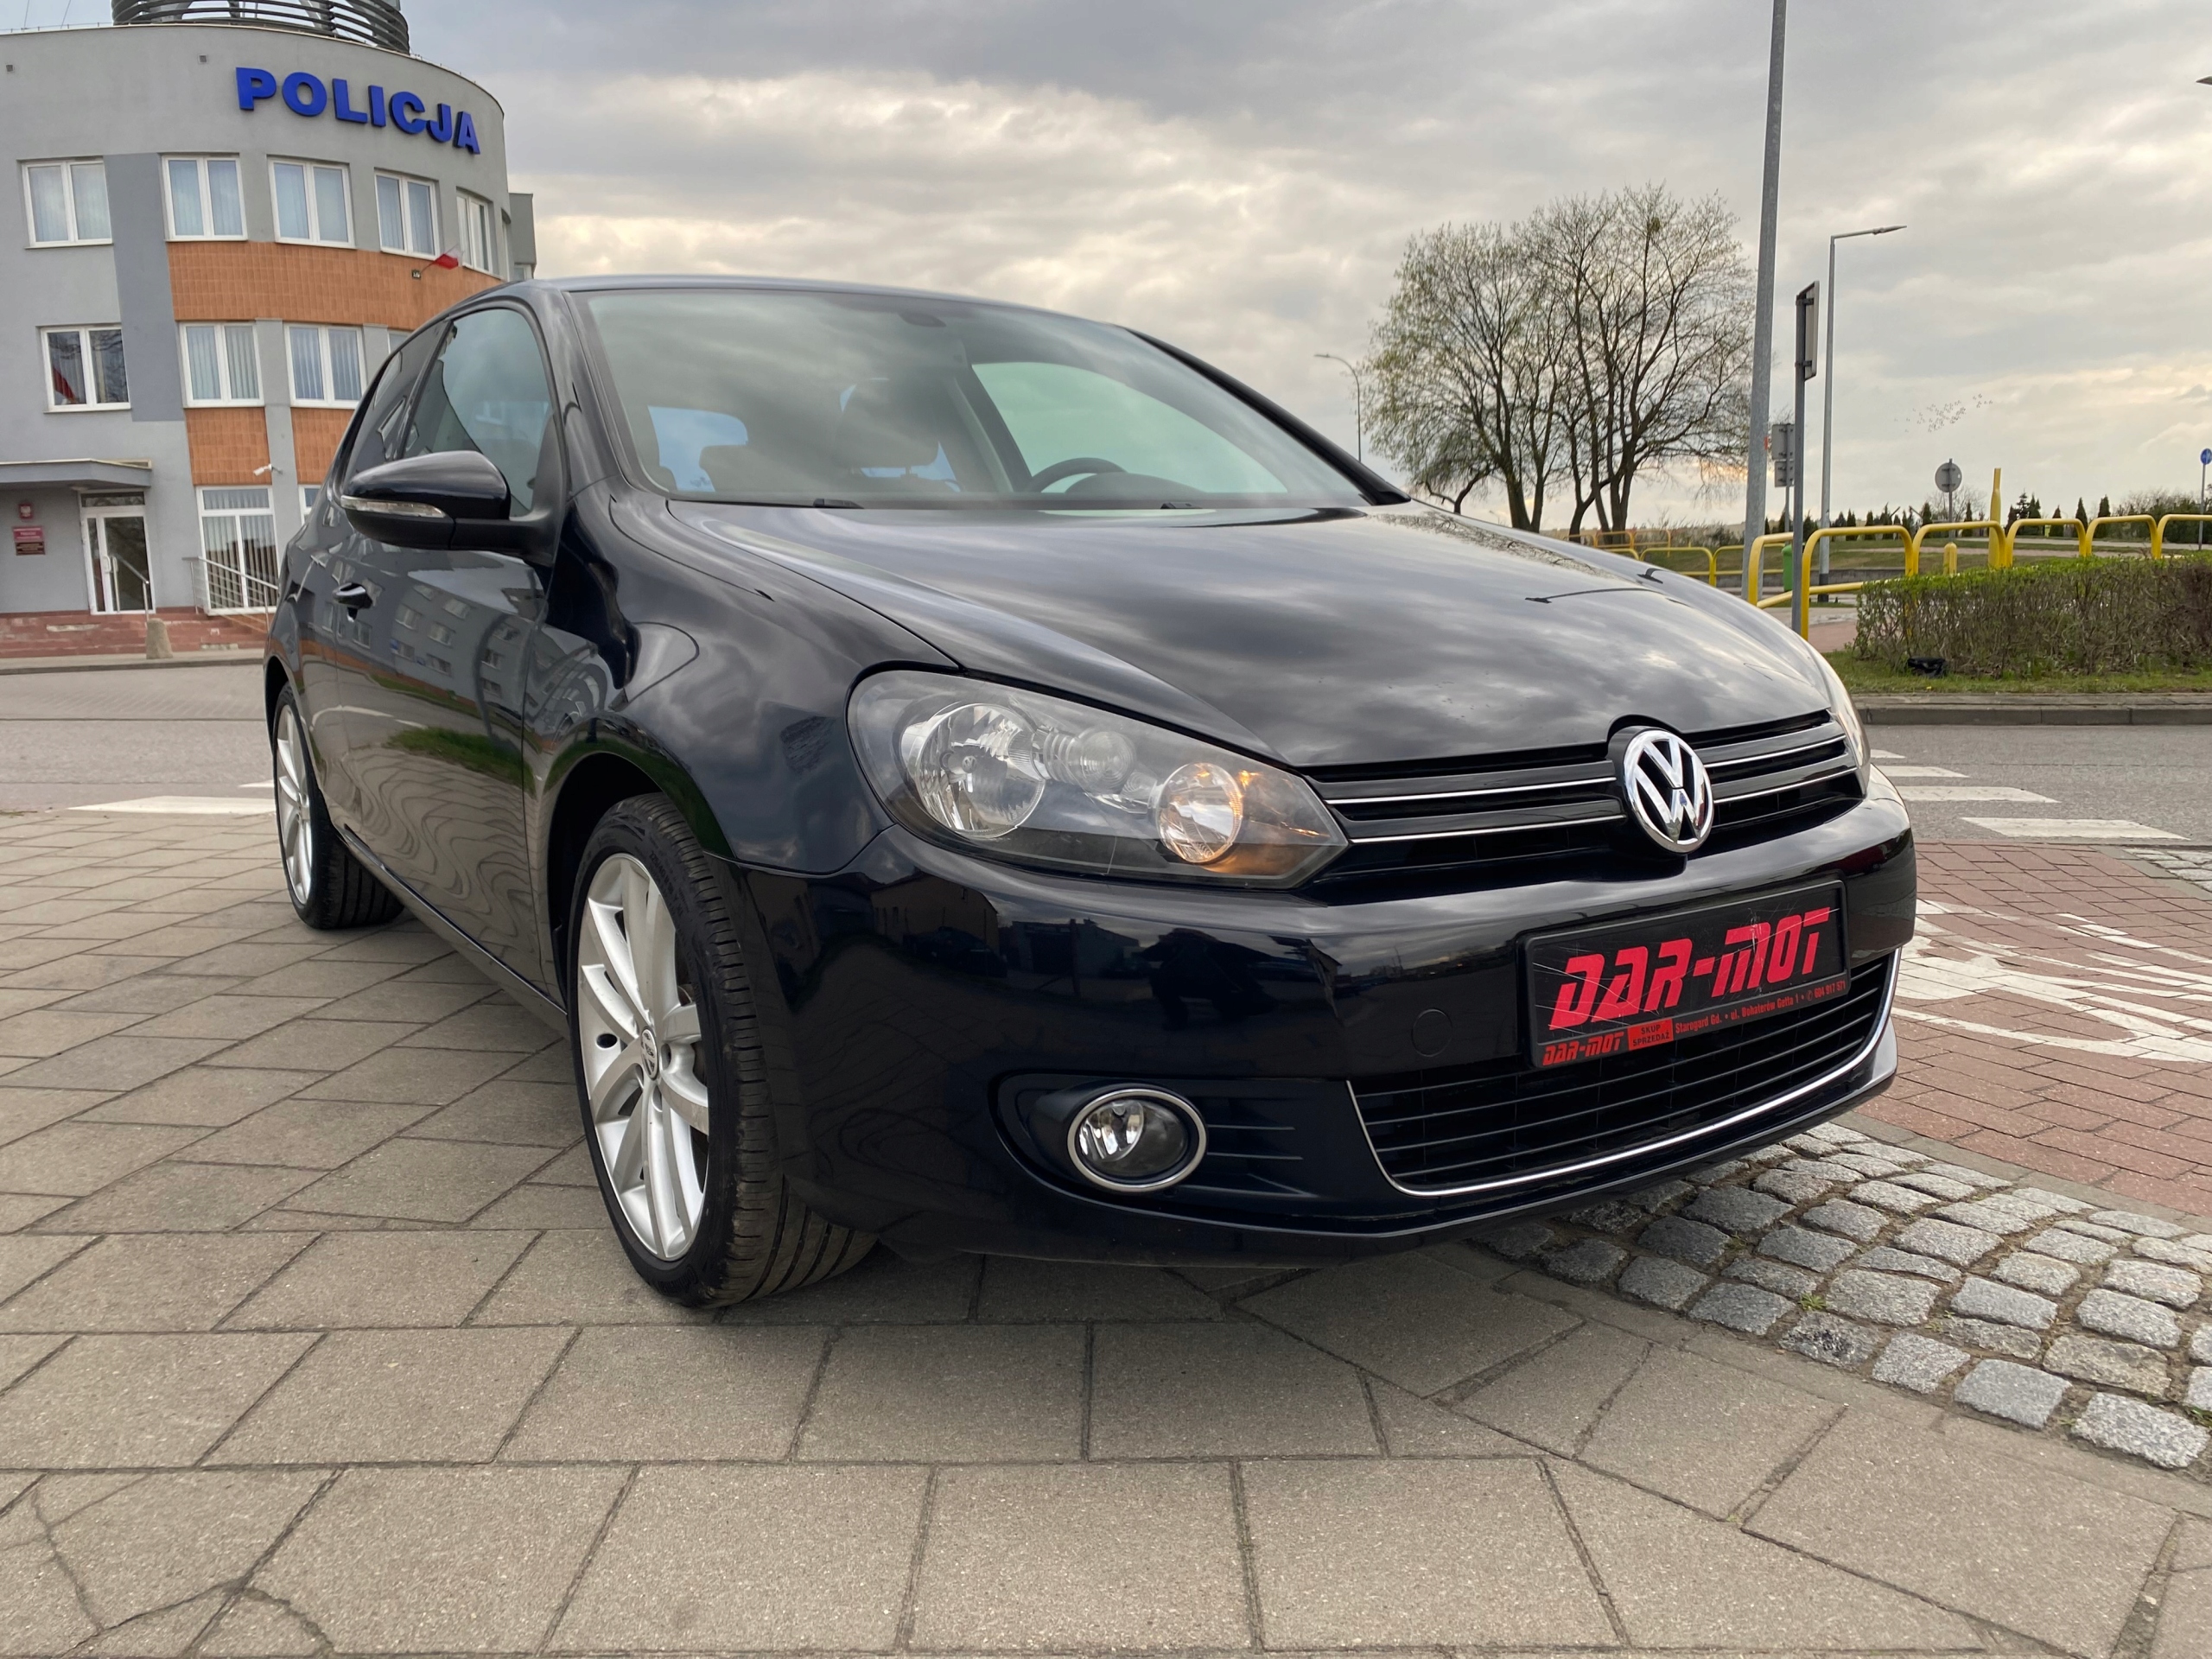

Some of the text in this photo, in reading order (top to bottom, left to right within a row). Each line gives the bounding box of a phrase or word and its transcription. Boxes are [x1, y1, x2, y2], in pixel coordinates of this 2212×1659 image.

[235, 67, 480, 155] POLICJA
[1549, 907, 1831, 1030] DAR-MOT
[1641, 1024, 1661, 1035] SKUP
[1675, 1015, 1708, 1033] Starogard
[1711, 1014, 1722, 1025] Gd.
[1731, 1009, 1740, 1020] ul.
[1777, 996, 1794, 1008] Getta
[1542, 1032, 1624, 1065] DAR-MOT
[1632, 1030, 1670, 1046] SPRZEDAŻ
